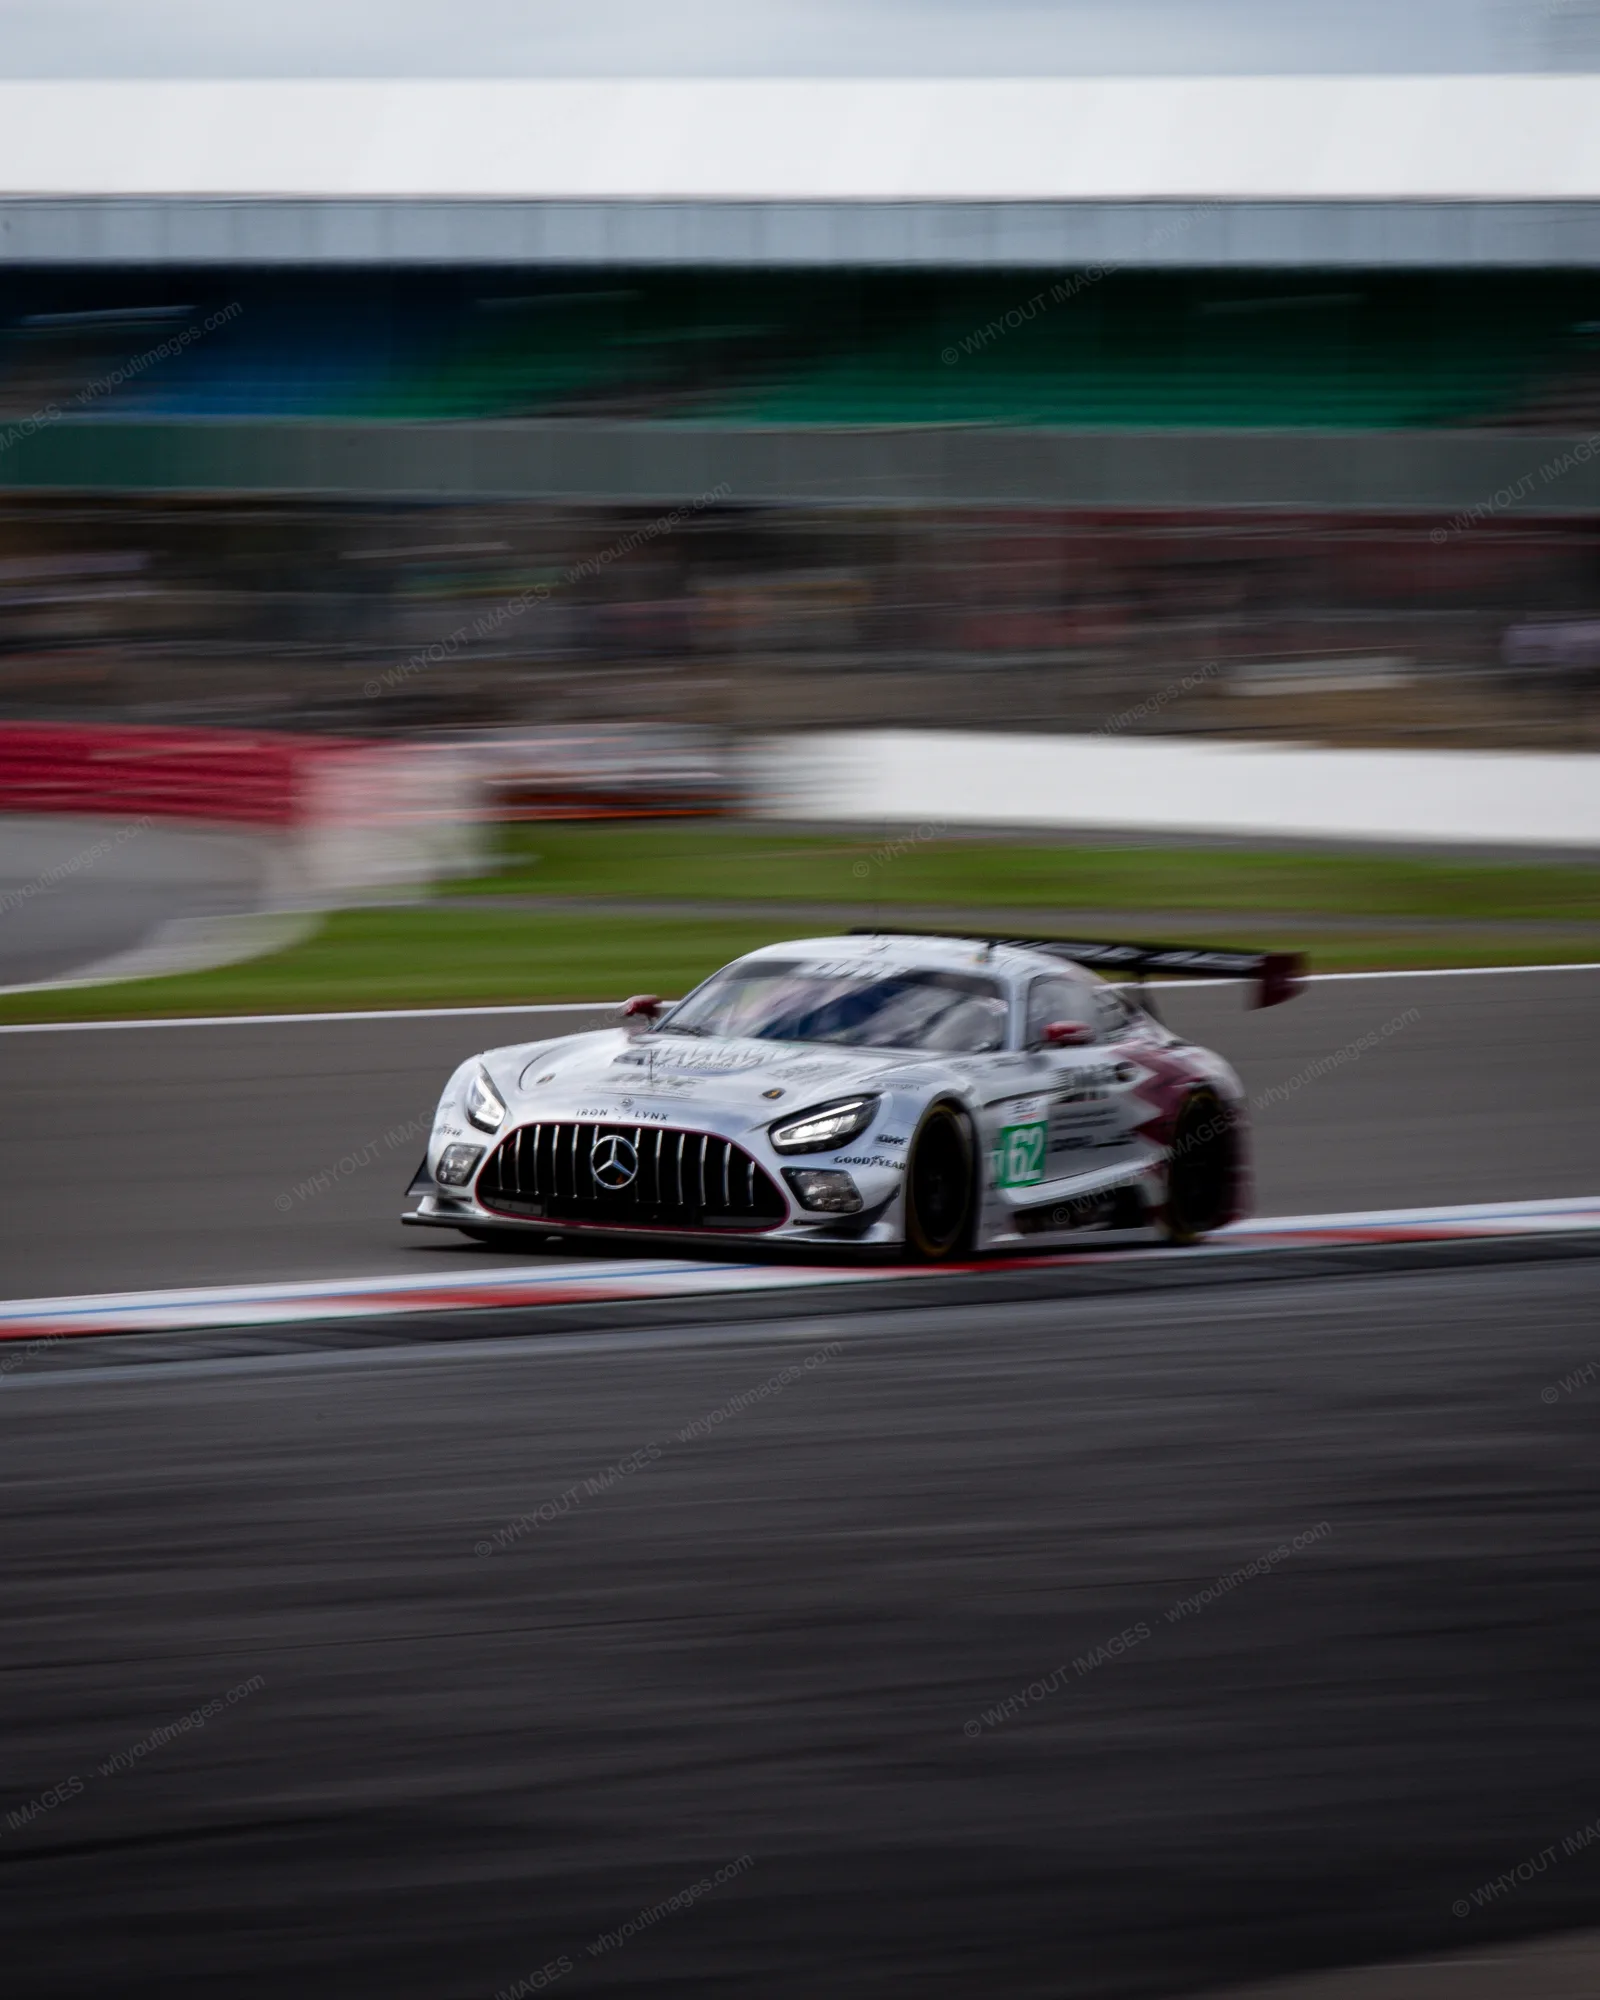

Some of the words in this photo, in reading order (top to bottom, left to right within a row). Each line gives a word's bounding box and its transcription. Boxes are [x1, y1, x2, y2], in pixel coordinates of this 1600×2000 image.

[576, 1108, 608, 1116] IRON
[634, 1110, 670, 1121] LYNX
[1007, 1126, 1045, 1182] 62
[833, 1155, 906, 1170] GOODYEAR
